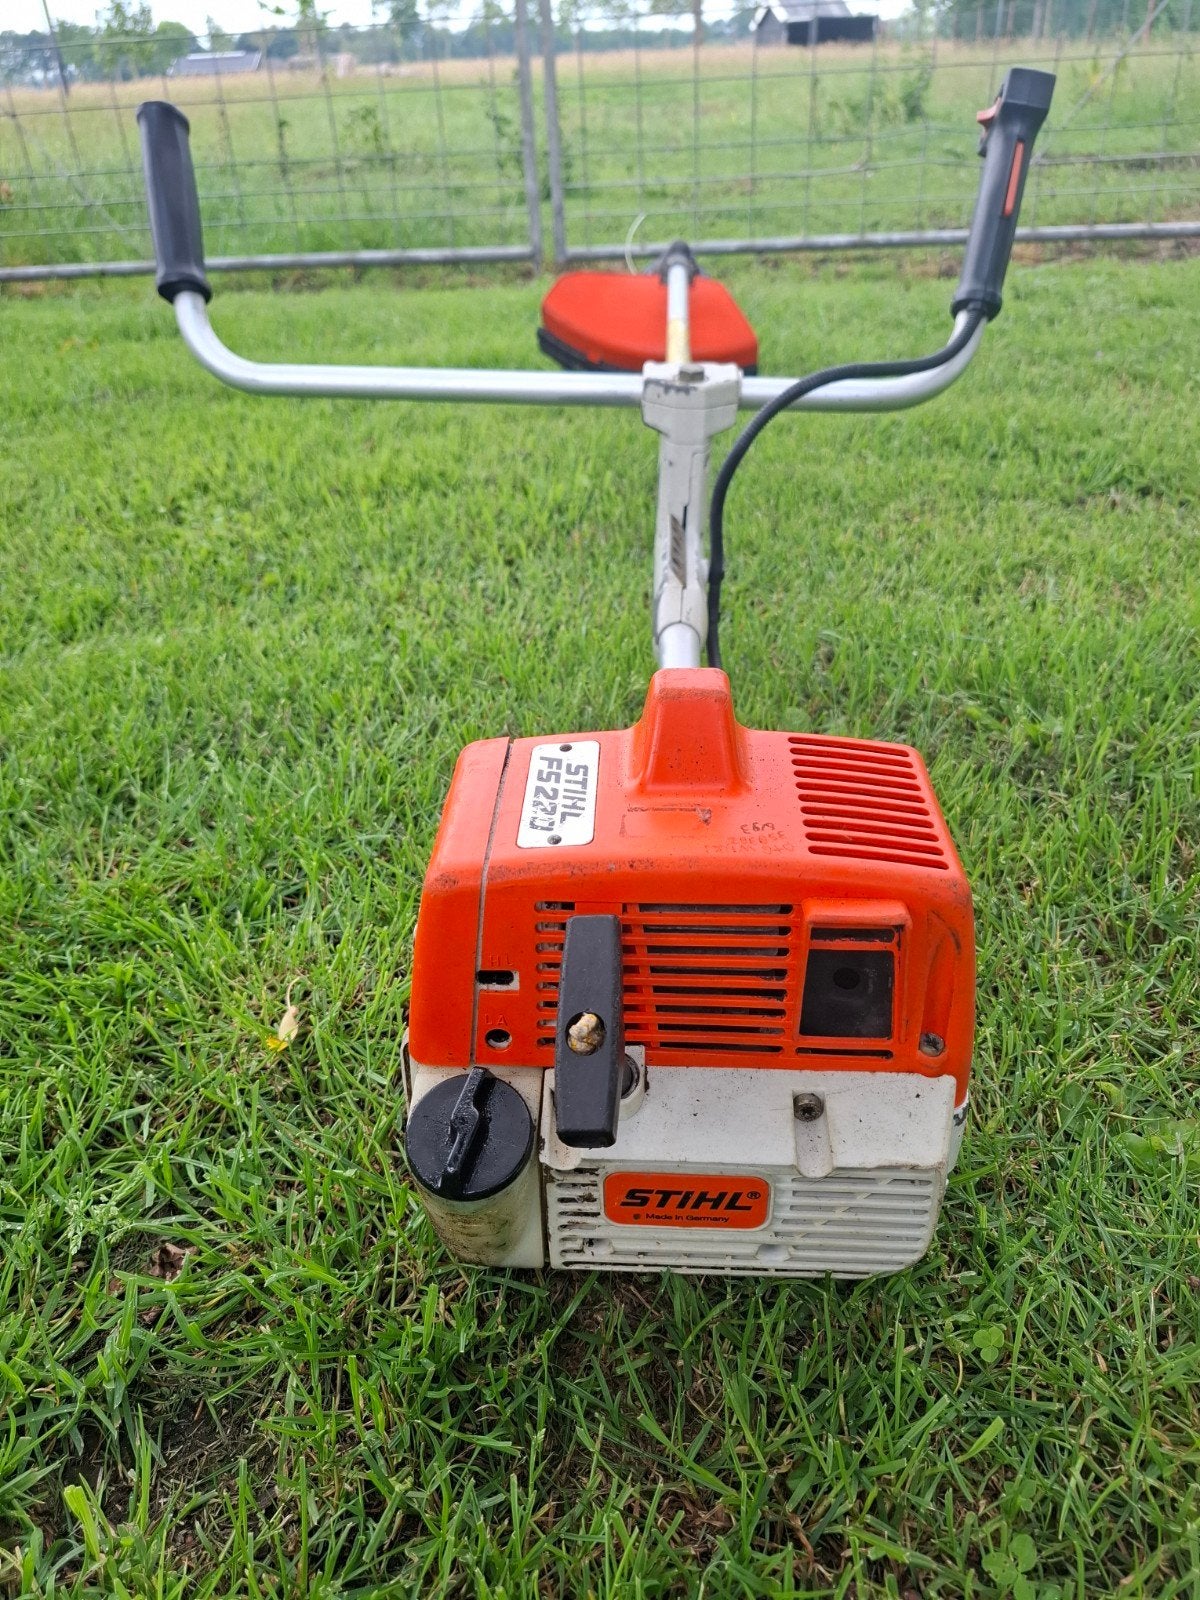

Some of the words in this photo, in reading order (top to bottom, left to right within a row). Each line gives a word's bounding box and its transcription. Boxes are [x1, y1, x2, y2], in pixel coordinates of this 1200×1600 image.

[559, 763, 589, 824] STIHL
[645, 1212, 673, 1221] Made
[685, 1215, 730, 1223] Germany
